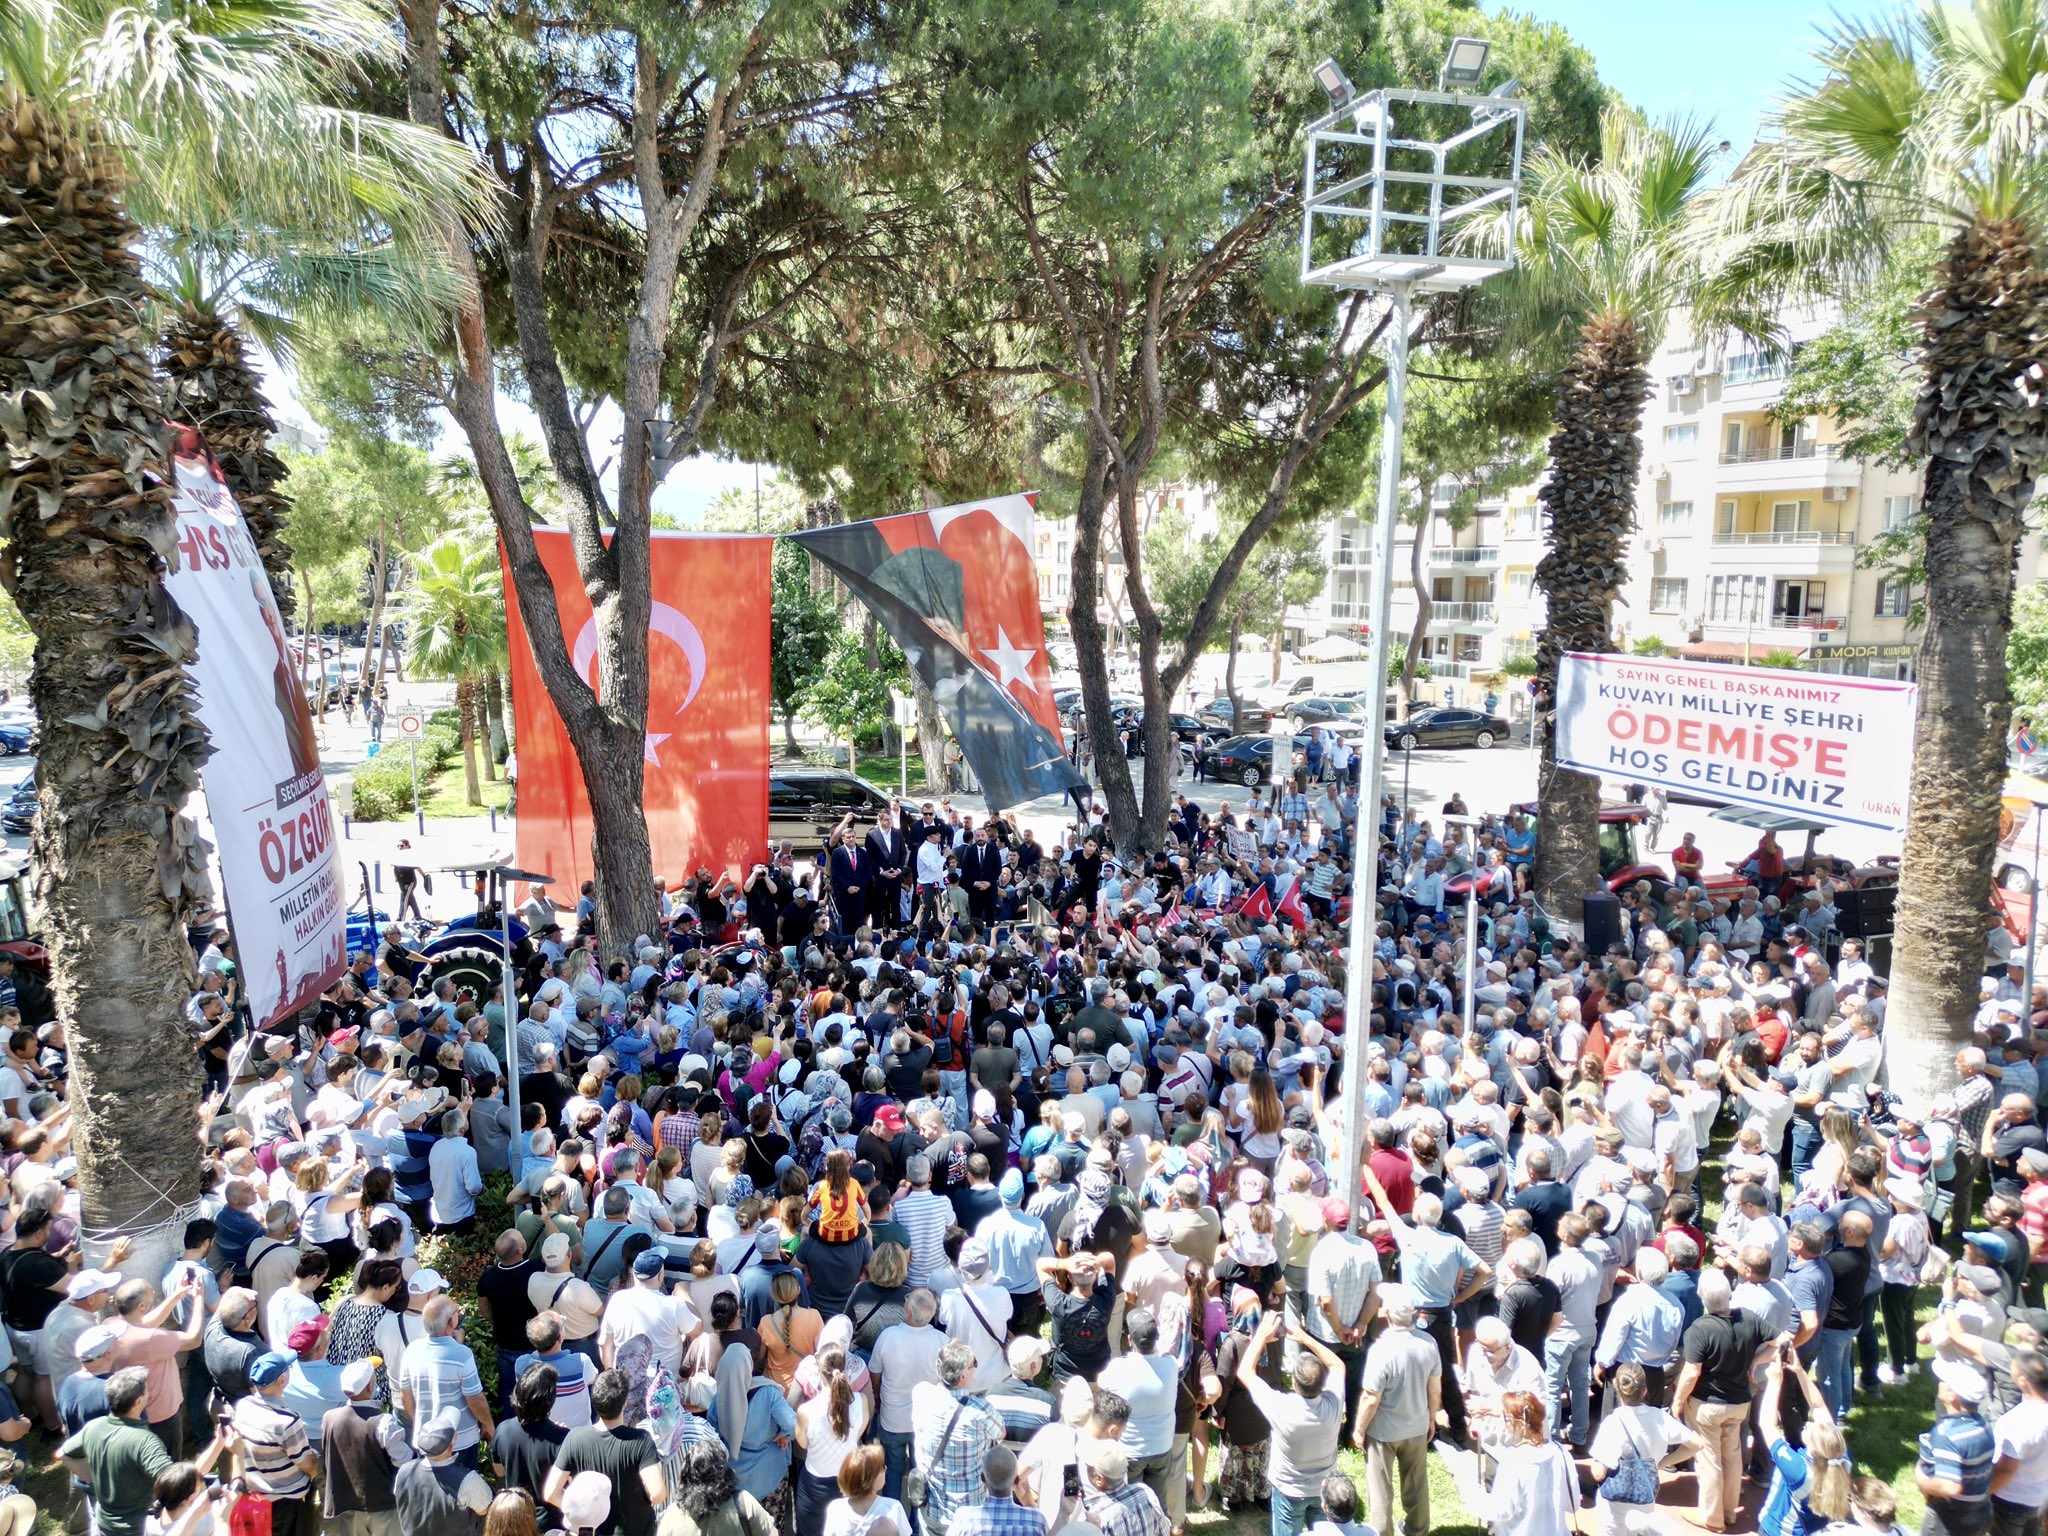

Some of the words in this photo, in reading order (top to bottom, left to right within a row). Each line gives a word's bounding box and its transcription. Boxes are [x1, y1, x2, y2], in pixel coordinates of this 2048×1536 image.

[1830, 646, 1878, 658] MODA
[1599, 683, 1673, 706] KUVAYI
[1682, 694, 1774, 721] MİLLİYE
[1784, 707, 1863, 733] ŞEHRİ
[1617, 668, 1660, 683] SAYIN
[1665, 674, 1718, 690] GENEL
[1724, 680, 1841, 704] BAŞKANIMIZ
[1607, 703, 1848, 778] ÖDEMİŞ'E
[1609, 745, 1669, 776] HOŞ
[1681, 759, 1845, 808] GELDİNİZ
[258, 794, 331, 885] ÖZGÜR
[279, 881, 320, 925] MİLLETİN
[294, 902, 325, 942] HALKIN
